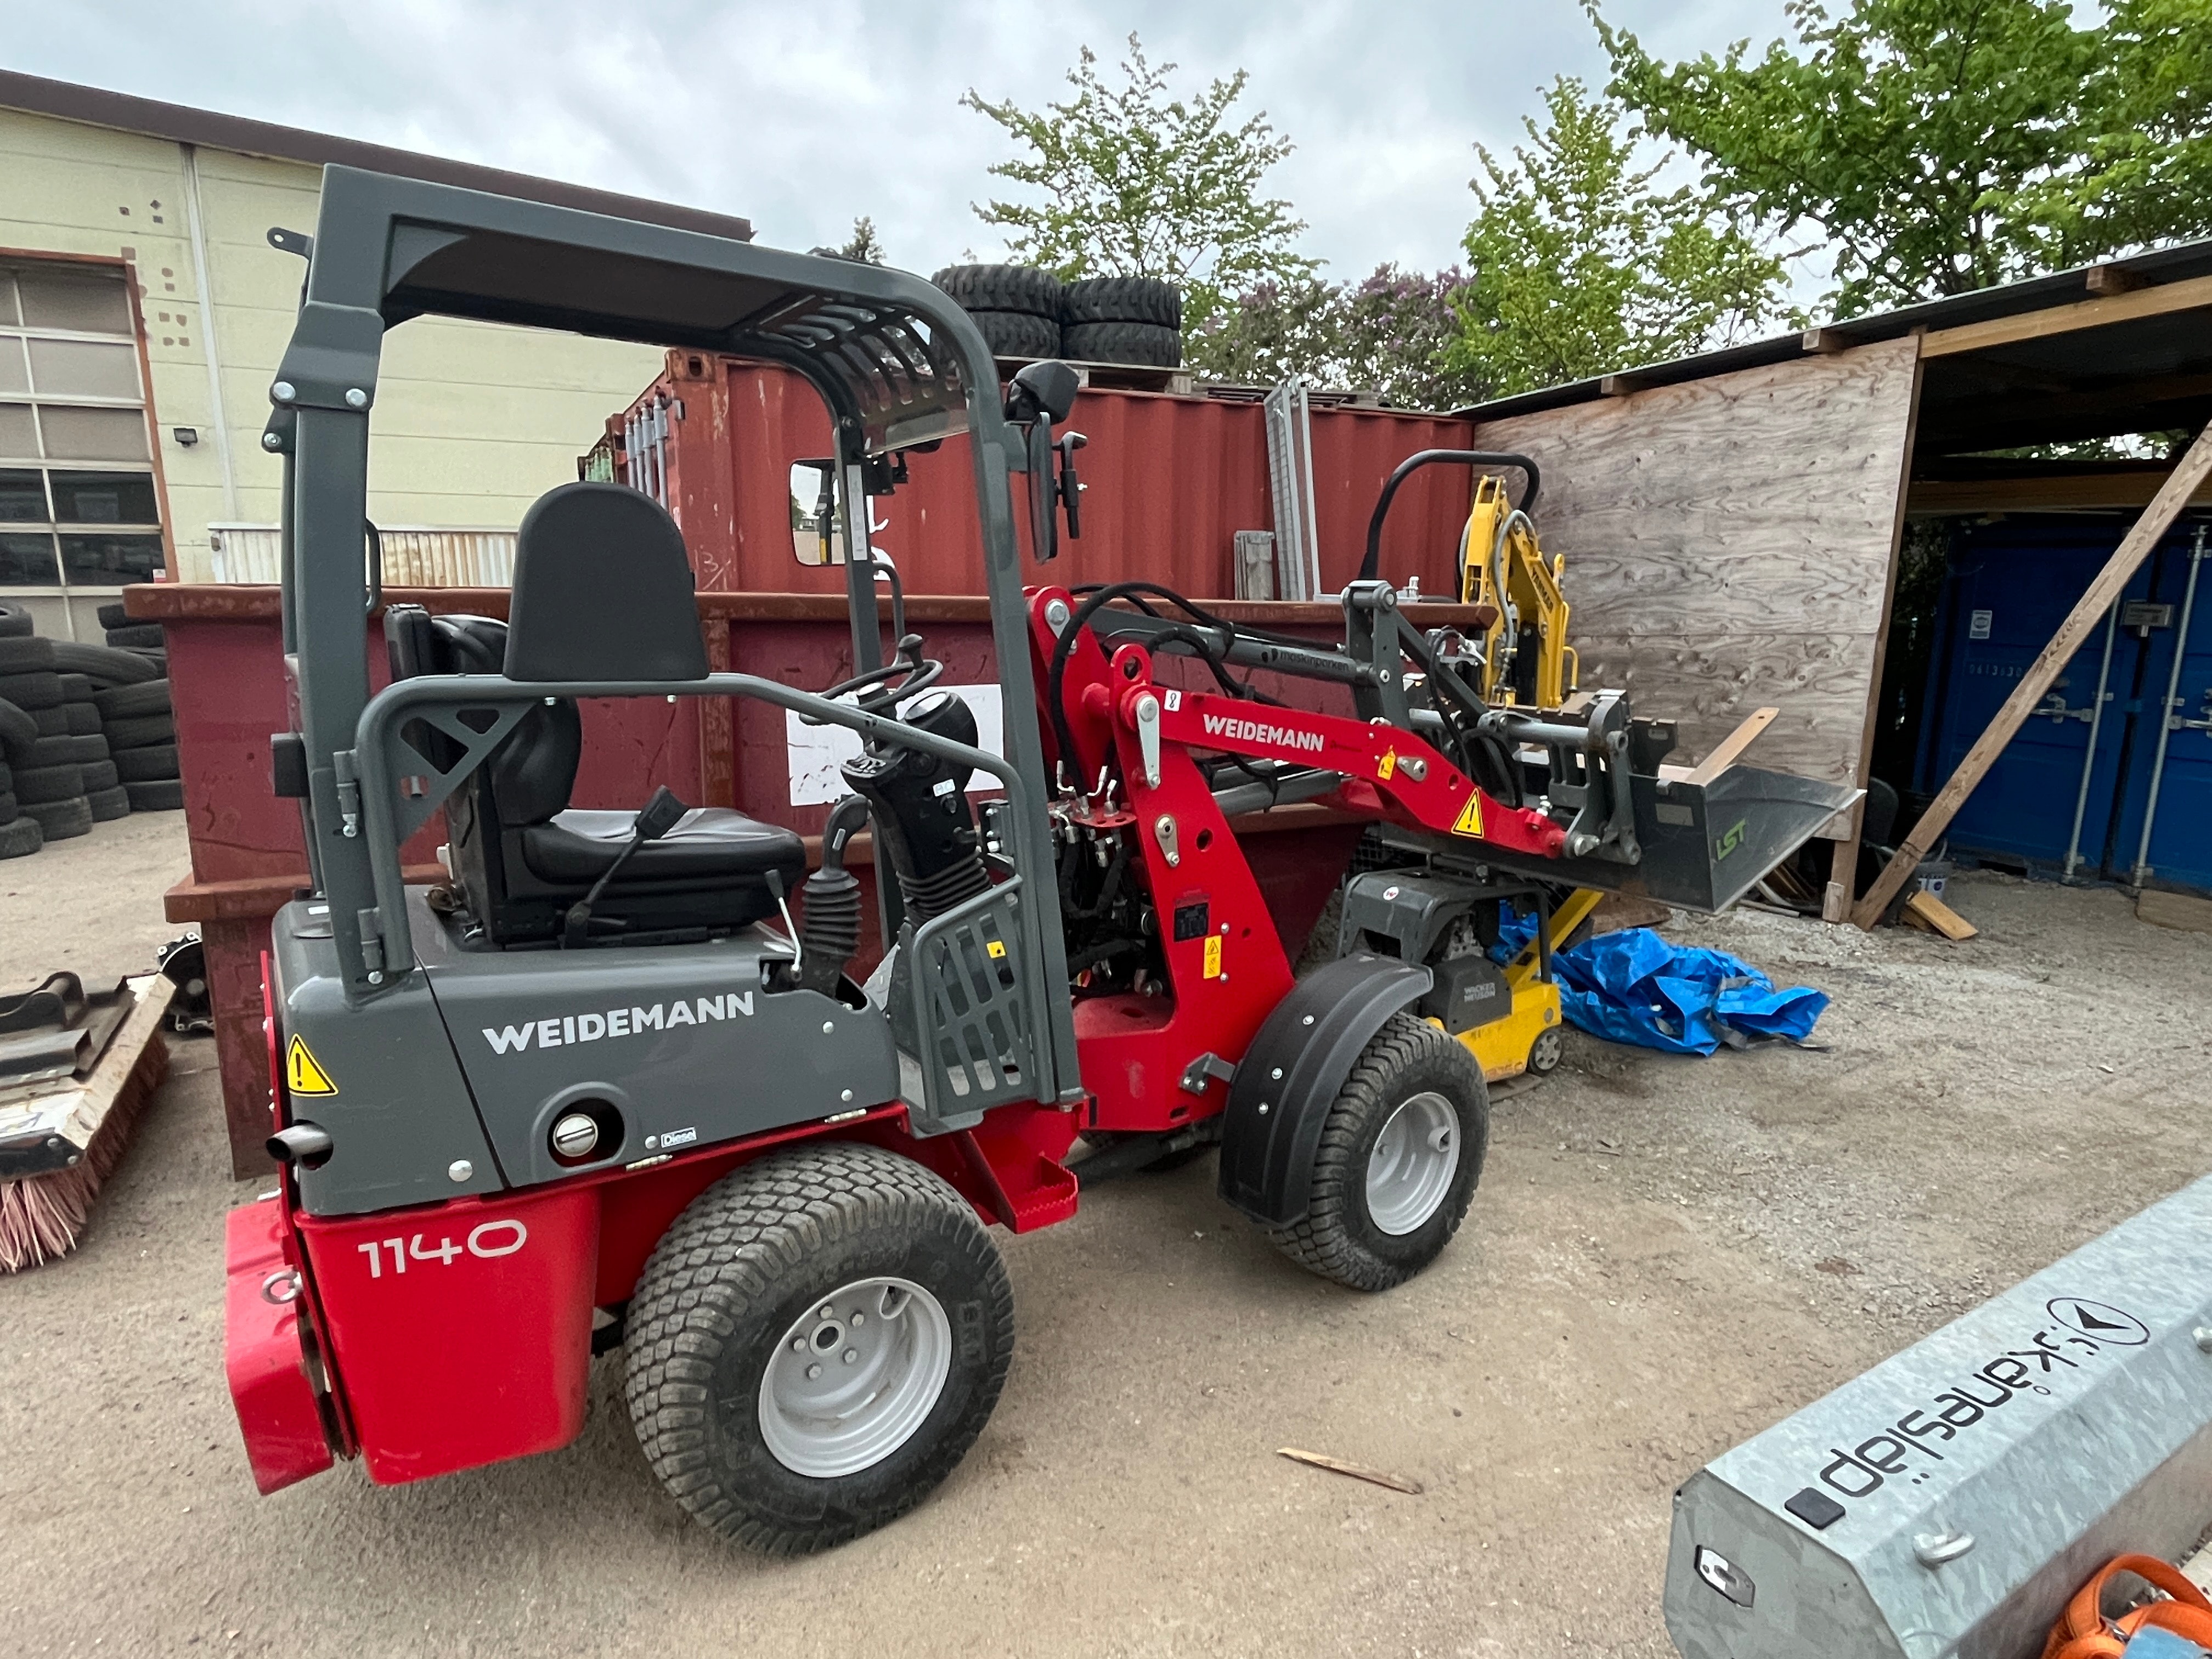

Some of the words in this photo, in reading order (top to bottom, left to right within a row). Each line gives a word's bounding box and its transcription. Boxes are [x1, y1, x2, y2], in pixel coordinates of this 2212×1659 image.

[1203, 714, 1324, 751] WEIDEMANN
[1716, 817, 1746, 860] LST
[482, 991, 754, 1054] WEIDEMANN
[664, 1130, 695, 1146] Diesel
[358, 1220, 527, 1278] 1140
